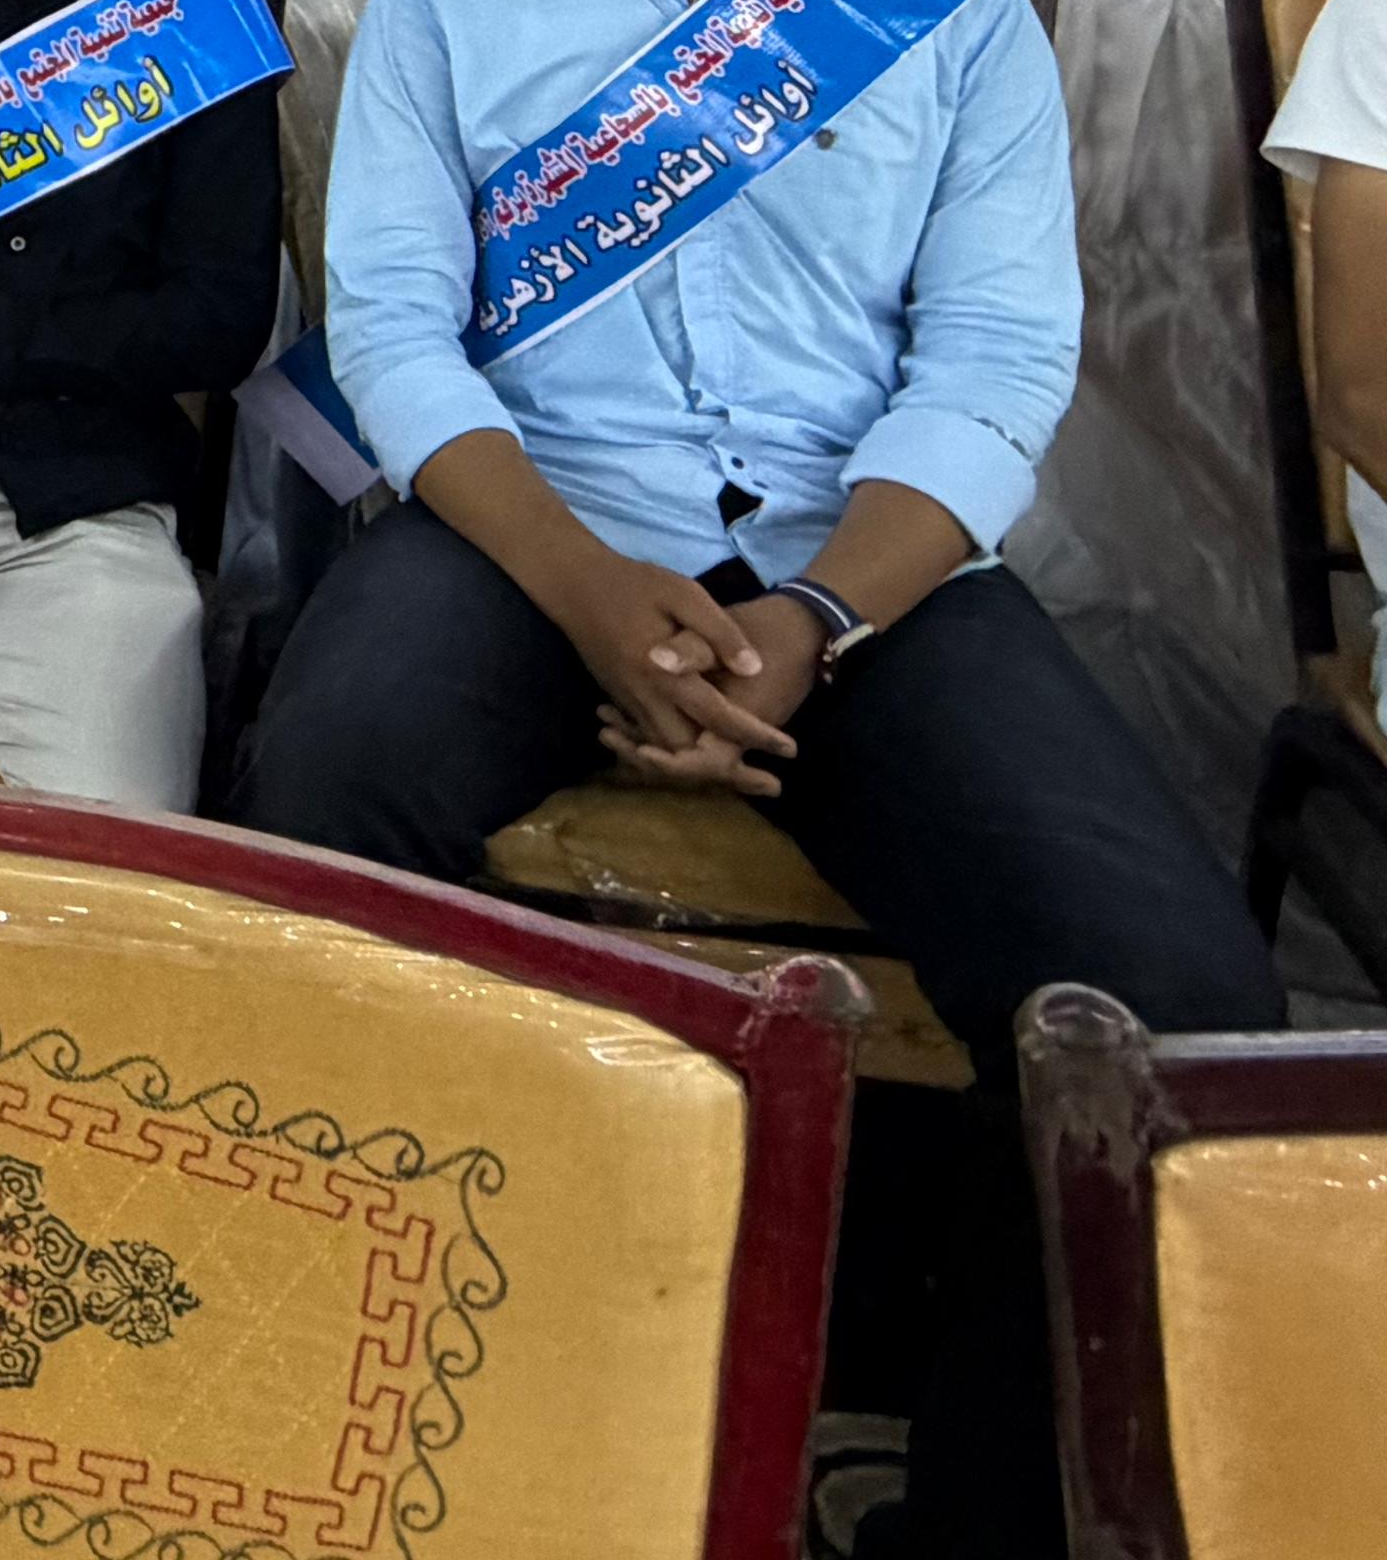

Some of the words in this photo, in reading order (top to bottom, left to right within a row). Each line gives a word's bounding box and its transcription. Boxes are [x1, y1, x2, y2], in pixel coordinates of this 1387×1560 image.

[17, 37, 81, 100] المجتمع
[67, 9, 130, 63] تنمية
[665, 28, 733, 105] المجتمع
[75, 55, 174, 150] أوائل
[732, 59, 818, 156] أوائل
[576, 136, 730, 251] الثانوية
